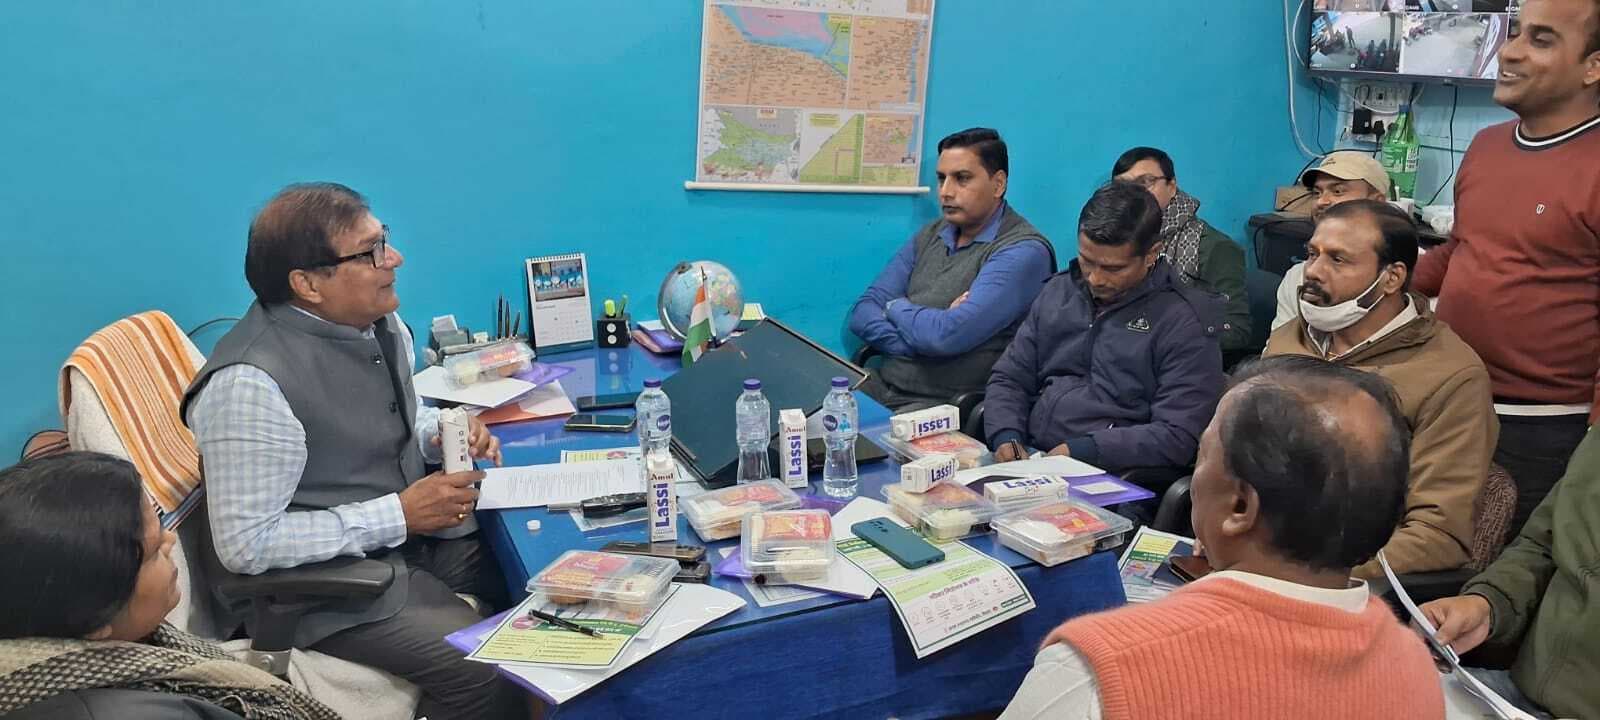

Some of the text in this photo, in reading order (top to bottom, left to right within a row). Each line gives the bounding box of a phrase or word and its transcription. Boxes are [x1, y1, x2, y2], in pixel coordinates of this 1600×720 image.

[918, 416, 950, 436] Lassi
[788, 434, 801, 476] Lassi
[650, 473, 674, 481] Amul
[931, 462, 952, 482] Lassi
[1003, 476, 1052, 489] Lassi
[653, 482, 669, 529] Lassi
